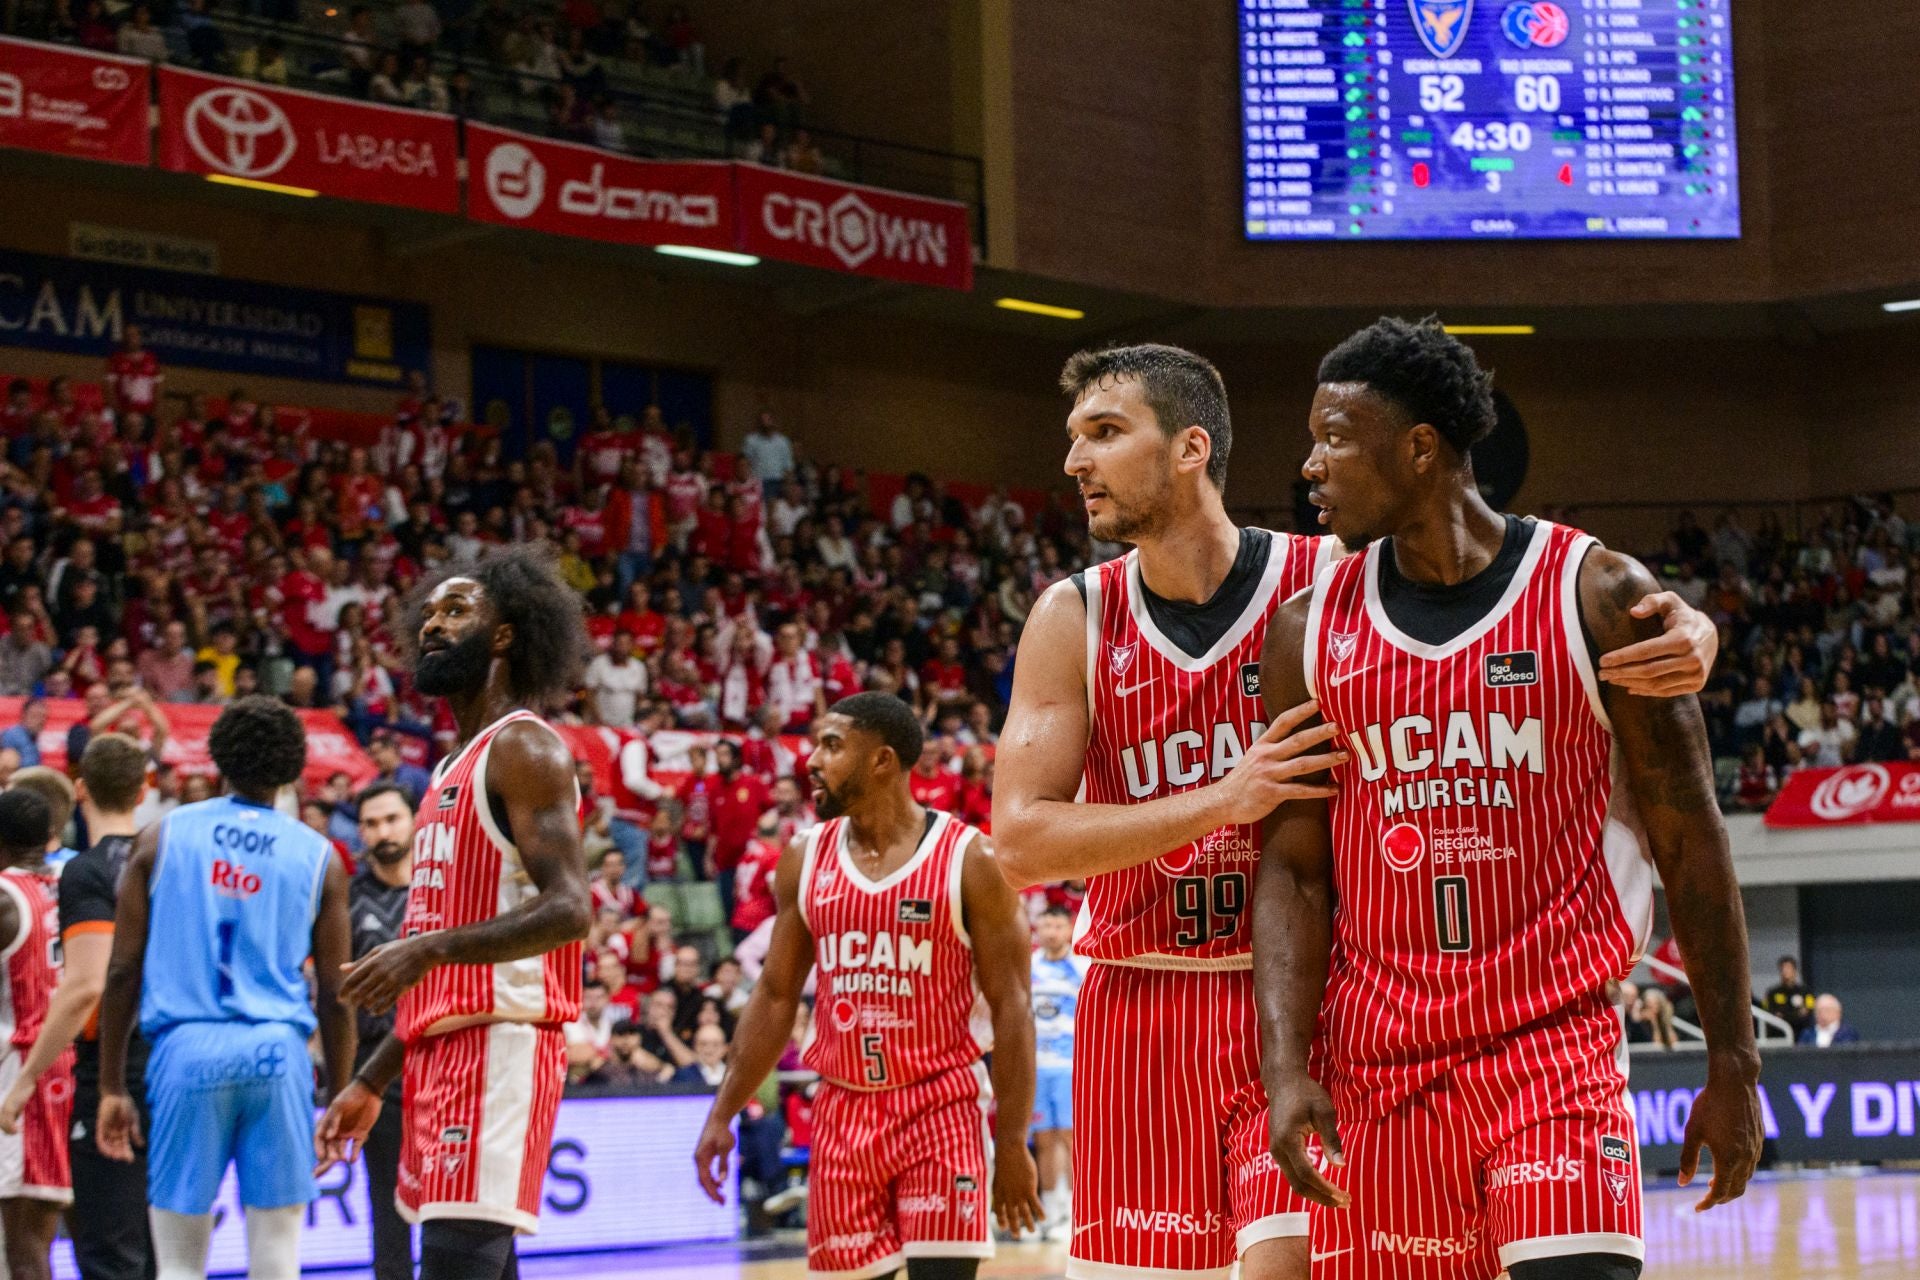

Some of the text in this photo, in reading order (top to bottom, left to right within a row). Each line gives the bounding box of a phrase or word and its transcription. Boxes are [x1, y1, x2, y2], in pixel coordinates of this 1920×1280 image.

[1419, 75, 1465, 112] 52
[1514, 75, 1561, 112] 60
[1451, 122, 1532, 151] 4:30
[315, 129, 438, 177] LABASA
[1485, 171, 1501, 193] 3
[762, 193, 947, 268] CROWN
[1246, 673, 1260, 684] lig
[1490, 664, 1511, 675] liga
[1491, 672, 1534, 683] endesa
[1349, 710, 1545, 783] UCAM
[1384, 777, 1515, 818] MURCIA
[213, 824, 277, 856] COOK
[1435, 847, 1518, 864] DE MURCIA
[1198, 850, 1261, 865] DE MURC
[1174, 872, 1246, 947] 99
[1433, 874, 1473, 953] 0
[820, 930, 933, 977] UCAM
[832, 972, 913, 997] MURCIA
[861, 1033, 887, 1084] 5
[1789, 1083, 1837, 1138] Y
[1851, 1080, 1920, 1137] DI
[1605, 1145, 1627, 1159] acb
[1116, 1207, 1222, 1235] INVERSUS
[1371, 1227, 1478, 1258] INVERSUS
